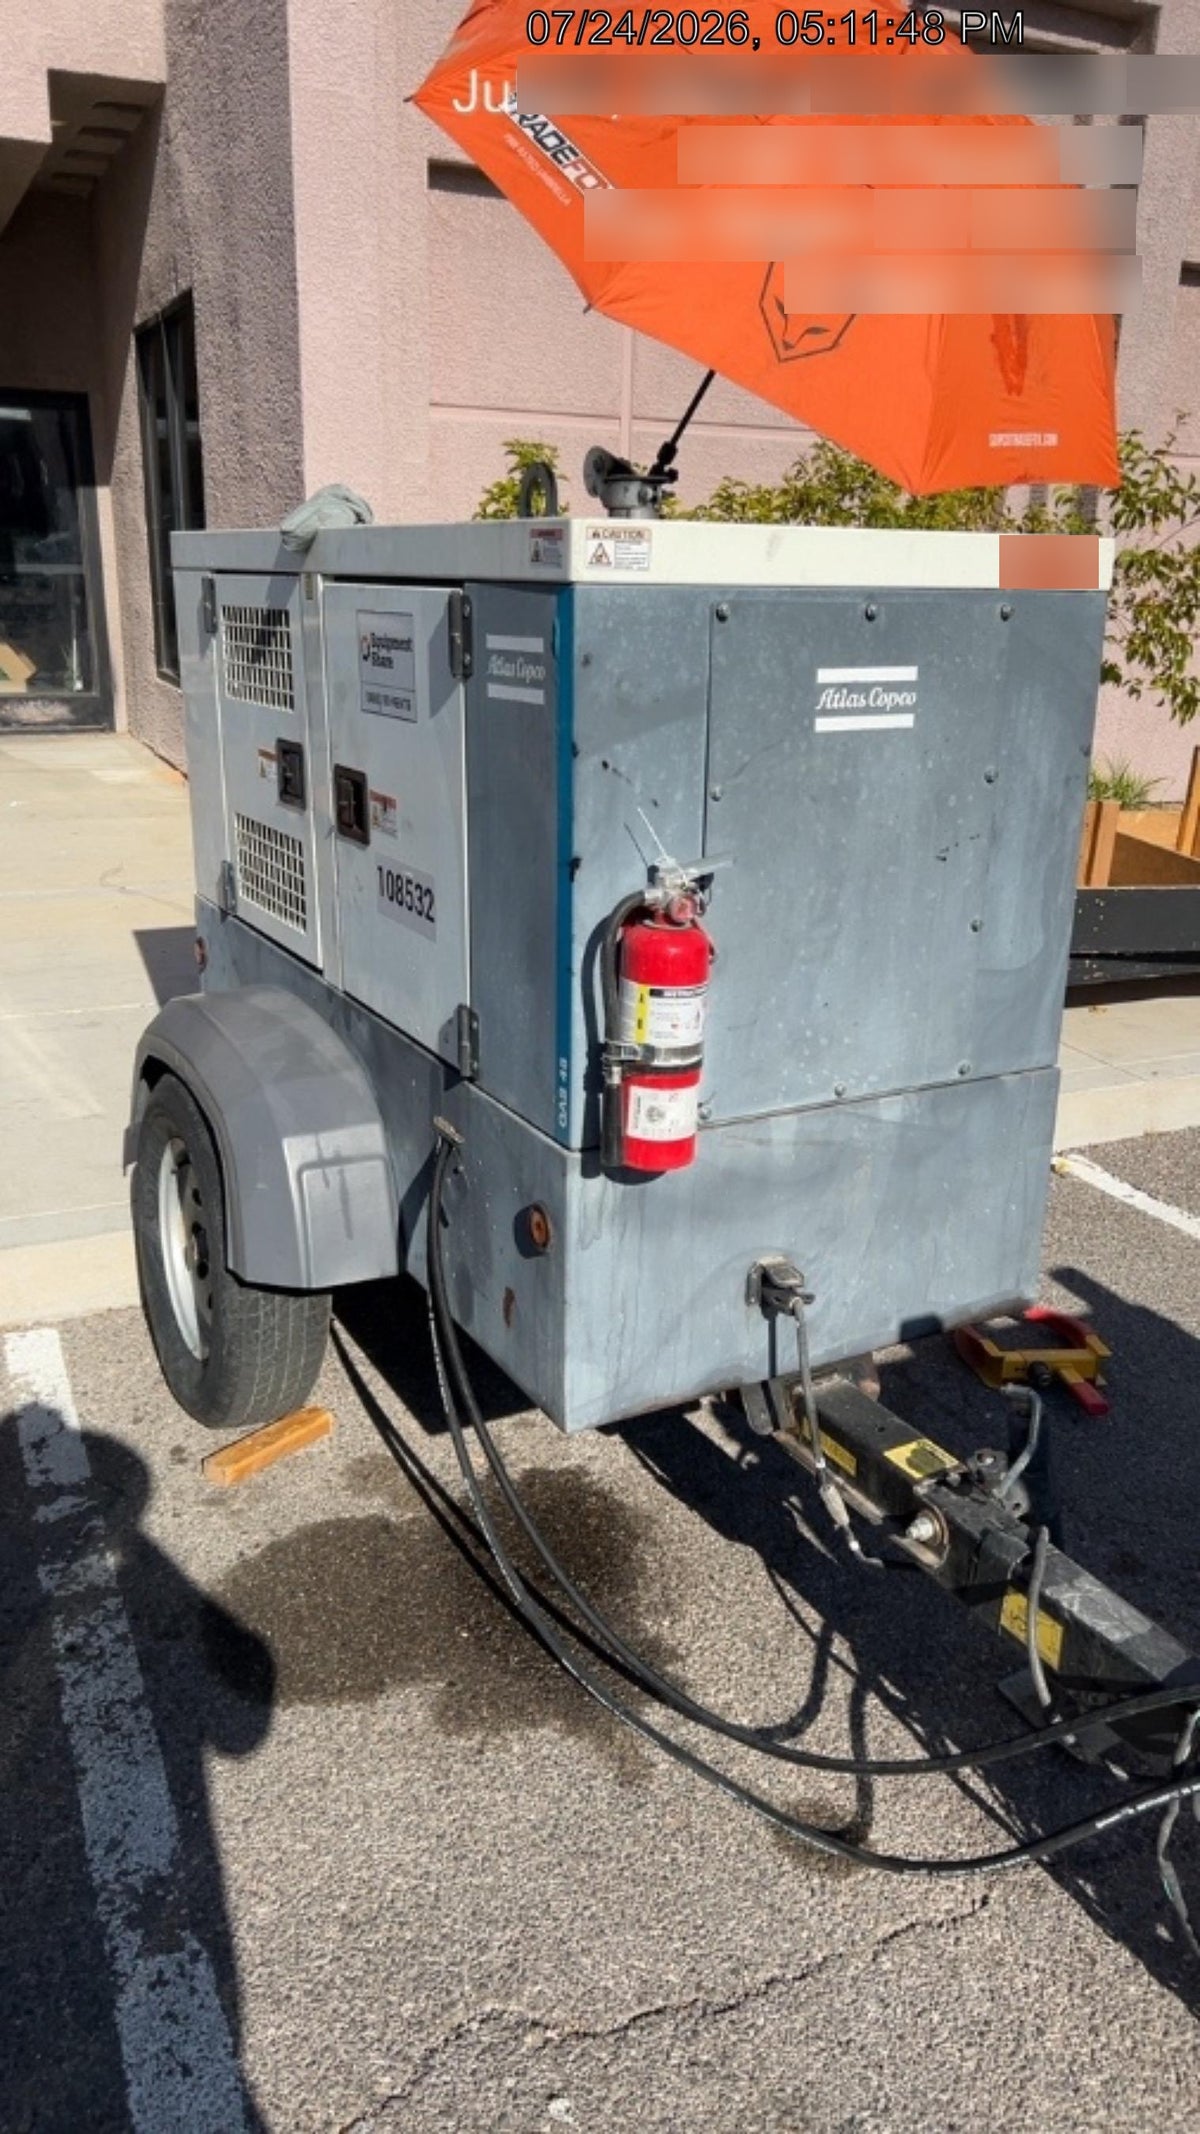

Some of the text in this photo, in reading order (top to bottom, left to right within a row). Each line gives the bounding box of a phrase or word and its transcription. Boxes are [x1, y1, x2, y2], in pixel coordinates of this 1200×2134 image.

[487, 653, 546, 684] Atlas Copco
[815, 686, 917, 712] Atlas Copco
[376, 865, 436, 924] 108532
